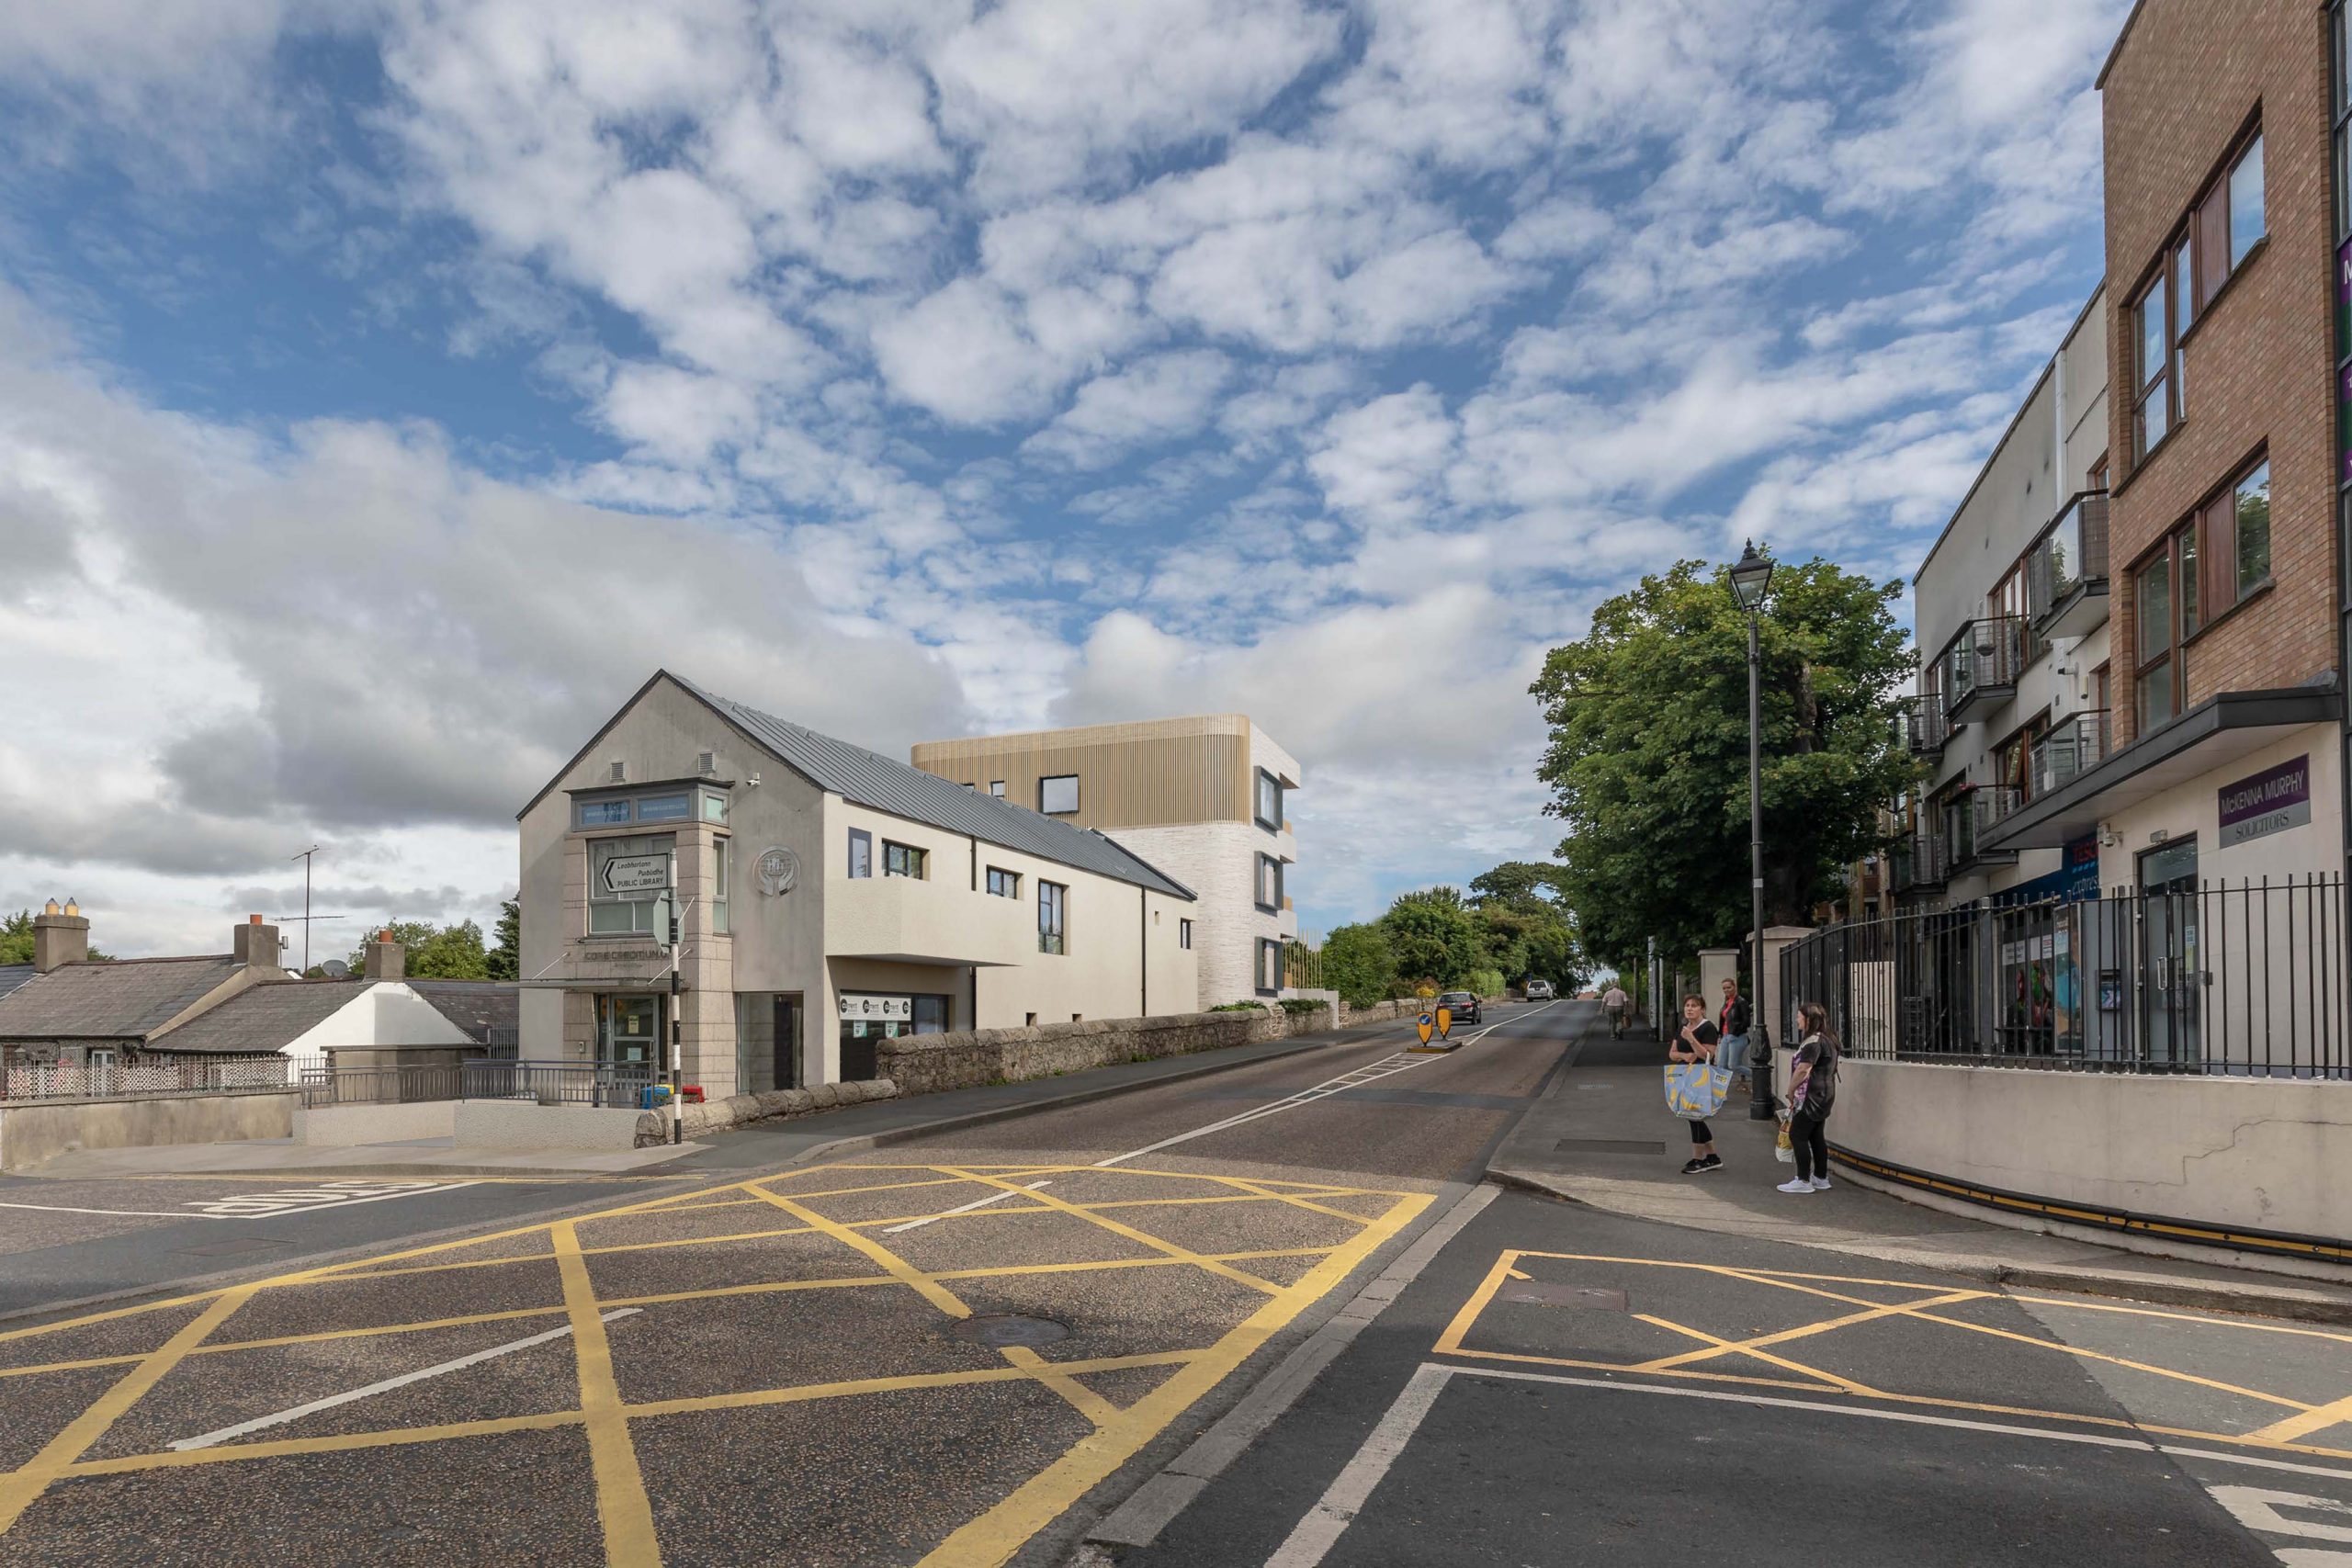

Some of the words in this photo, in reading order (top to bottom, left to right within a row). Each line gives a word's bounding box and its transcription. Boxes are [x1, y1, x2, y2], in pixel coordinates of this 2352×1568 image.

[2221, 786, 2264, 817] McKENNA
[2265, 770, 2304, 802] MURPHY
[2235, 811, 2290, 840] SOLICITORS
[2072, 839, 2098, 864] TESC
[617, 879, 638, 887] PUBLIC
[639, 877, 663, 886] LIBRARY
